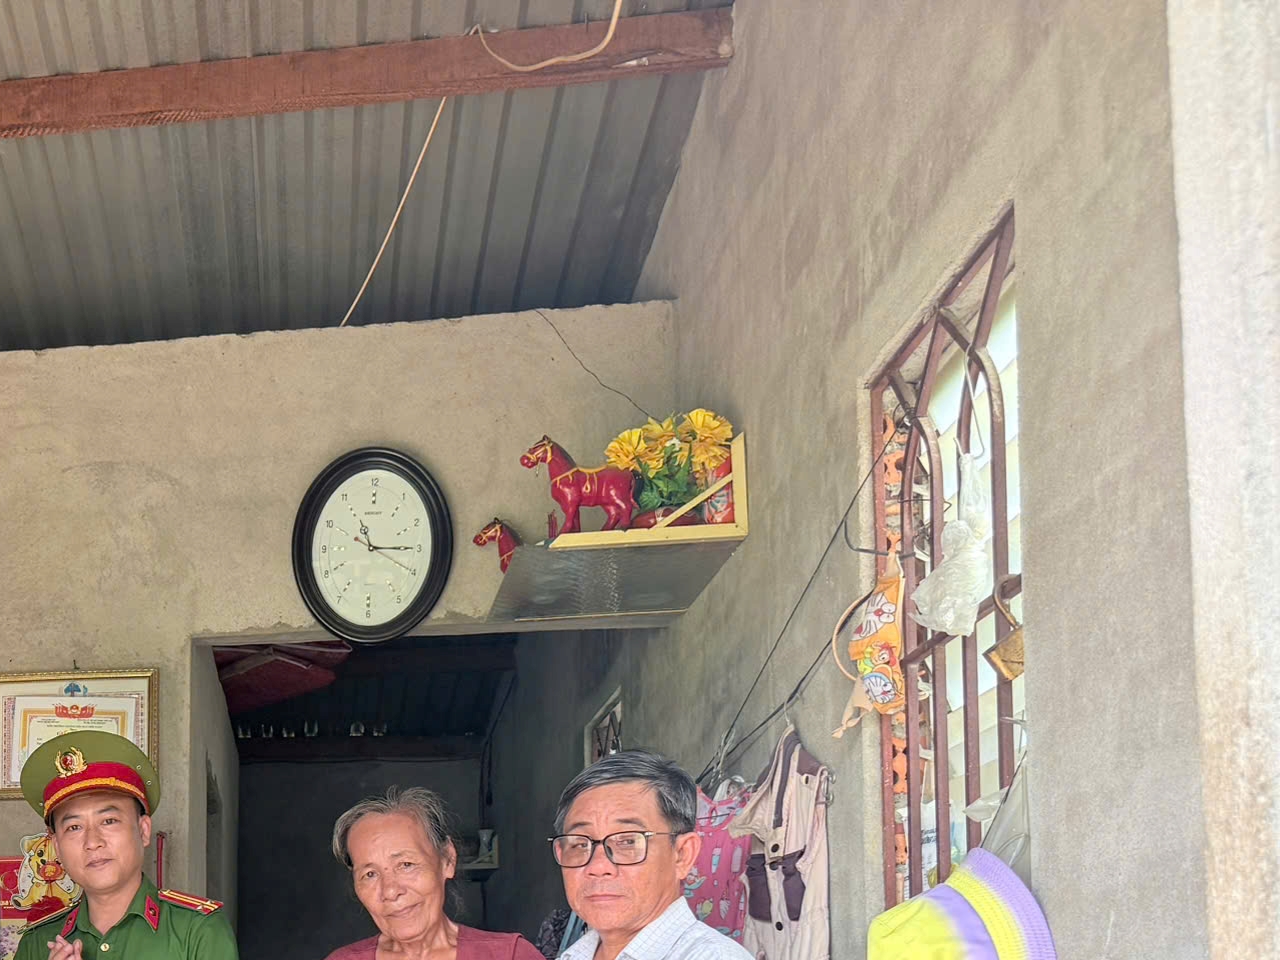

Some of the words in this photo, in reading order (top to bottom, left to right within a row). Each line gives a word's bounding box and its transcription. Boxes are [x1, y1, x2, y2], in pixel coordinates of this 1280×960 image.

[371, 477, 379, 487] 12
[341, 493, 348, 501] 11
[402, 492, 406, 501] 1
[326, 520, 333, 528] 10
[413, 518, 420, 527] 2
[322, 545, 327, 553] 9
[417, 545, 422, 553] 3
[324, 570, 329, 579] 8
[337, 595, 342, 604] 7
[396, 595, 402, 604] 5
[365, 609, 371, 618] 6
